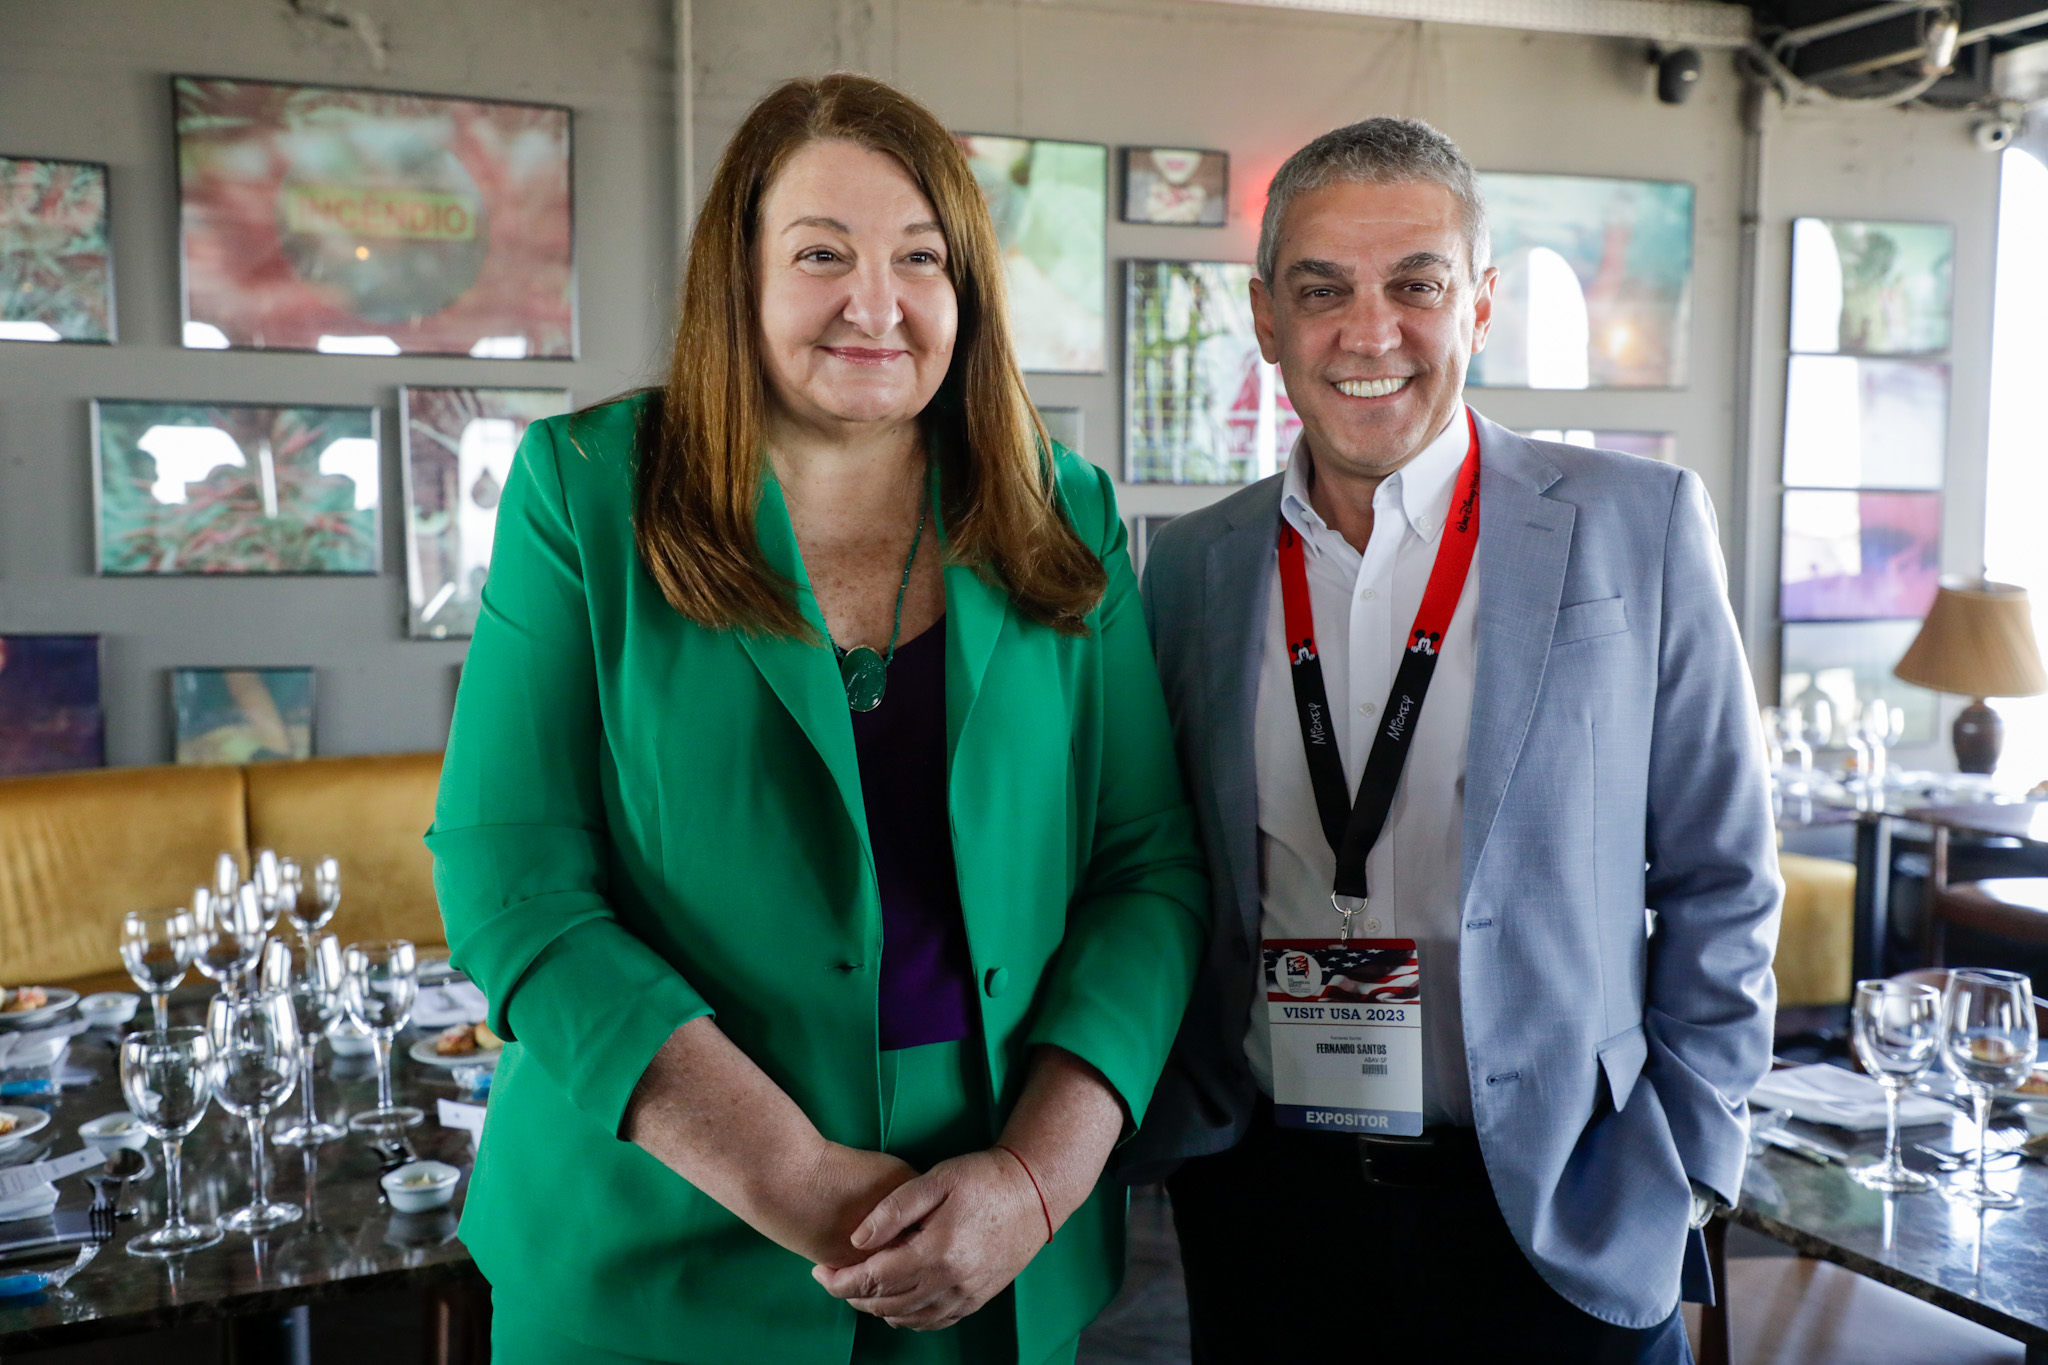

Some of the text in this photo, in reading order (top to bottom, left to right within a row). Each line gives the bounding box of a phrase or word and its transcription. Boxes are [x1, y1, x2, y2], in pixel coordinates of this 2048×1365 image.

[1283, 1007, 1405, 1021] VISIT USA 2023
[1316, 1043, 1387, 1055] FERNANDO SANTOS
[1305, 1111, 1389, 1128] EXPOSITOR
